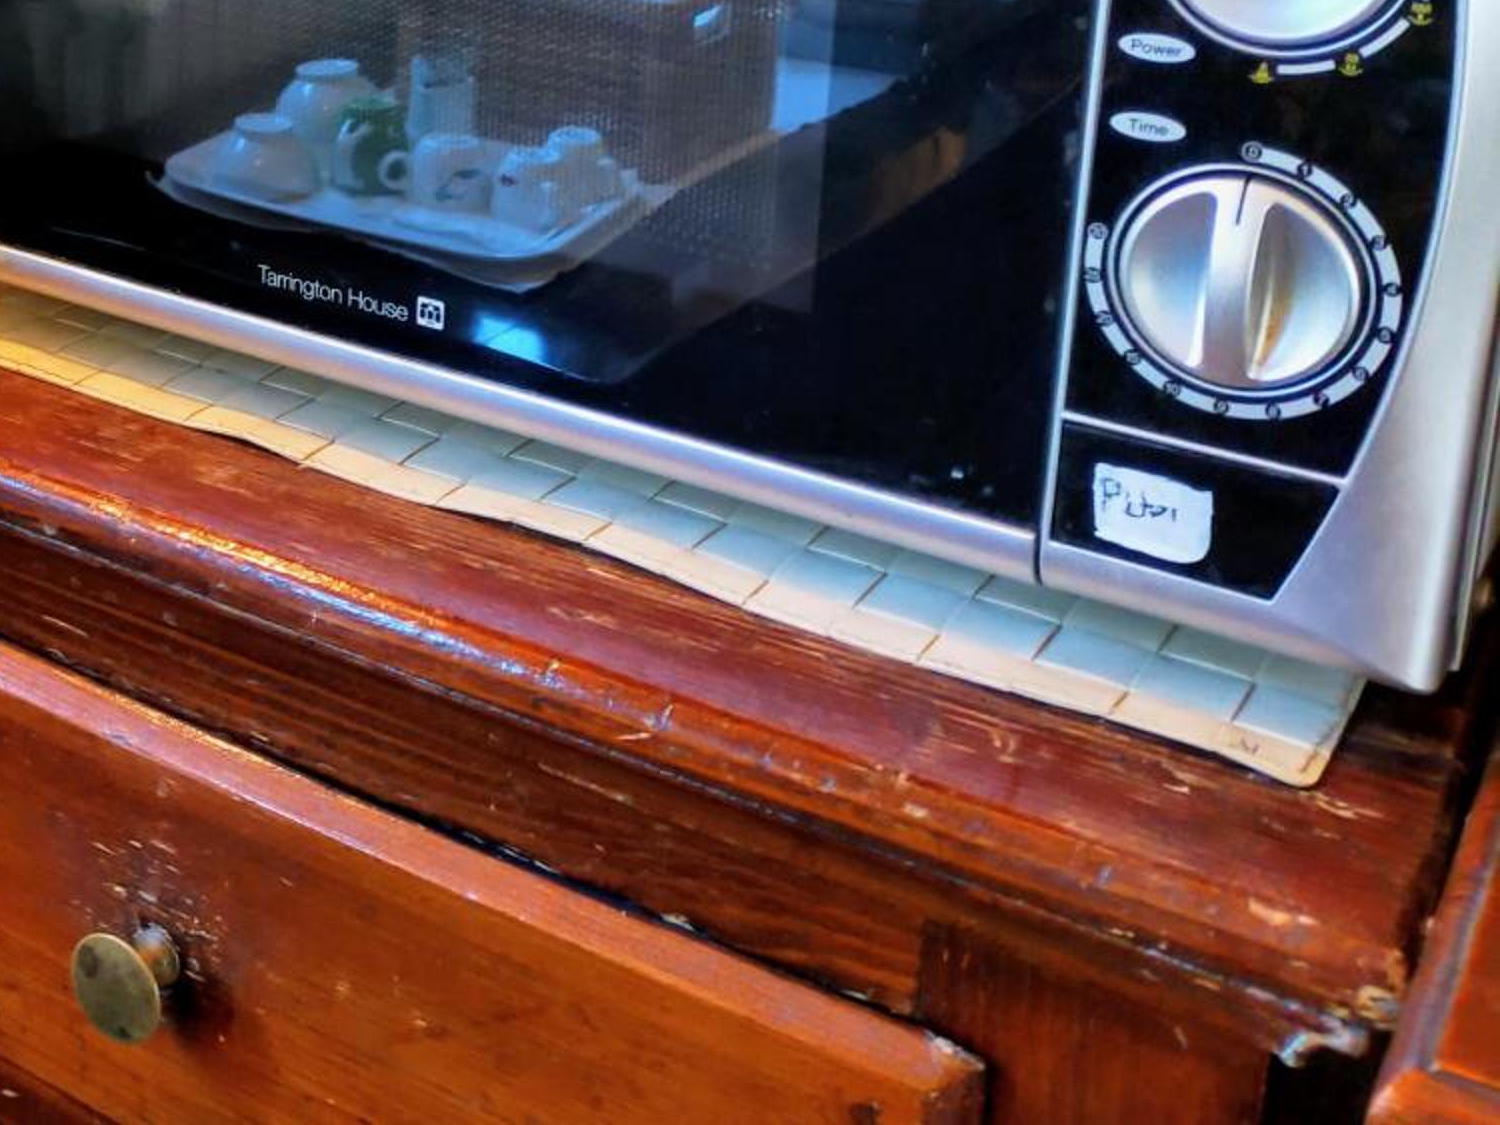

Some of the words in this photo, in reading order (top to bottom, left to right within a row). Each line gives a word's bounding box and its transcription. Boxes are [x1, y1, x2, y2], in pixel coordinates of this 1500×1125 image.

[1131, 38, 1183, 56] Power
[1129, 118, 1170, 137] Time
[257, 263, 343, 305] Tarrington
[347, 287, 409, 322] House
